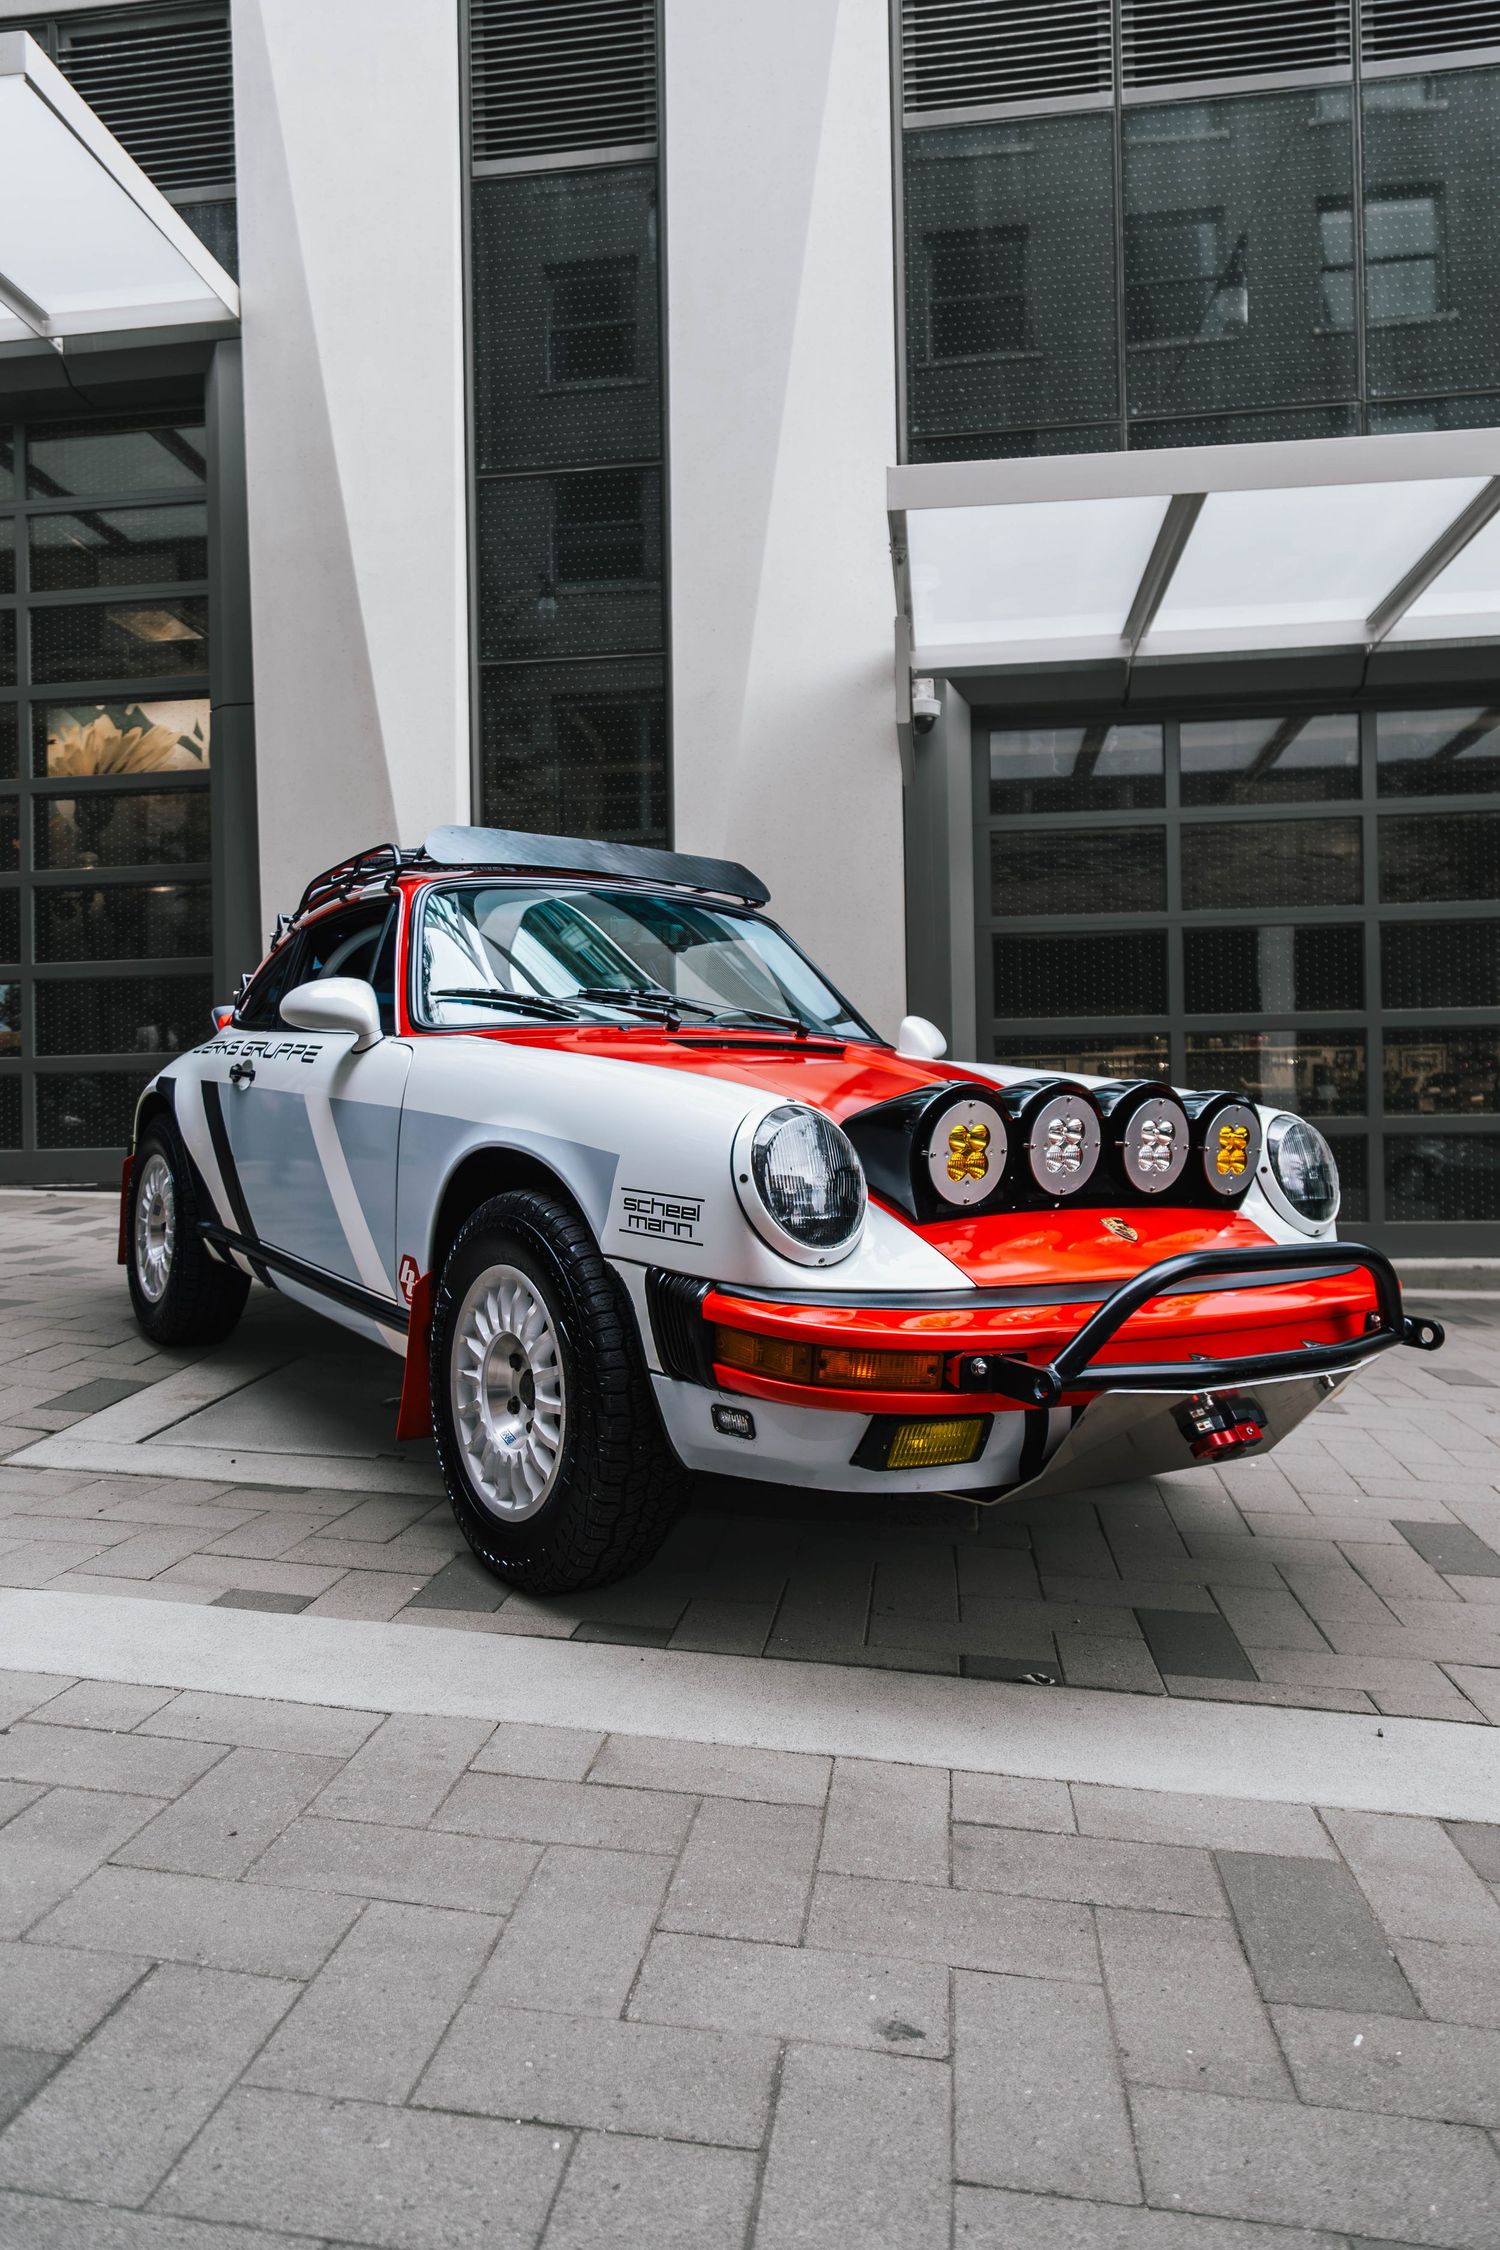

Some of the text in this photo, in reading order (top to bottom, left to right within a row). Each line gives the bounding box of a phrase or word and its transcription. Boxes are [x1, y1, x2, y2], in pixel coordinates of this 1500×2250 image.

[241, 1041, 323, 1064] GRUPPE
[623, 1197, 701, 1222] scheel
[628, 1214, 693, 1238] mann
